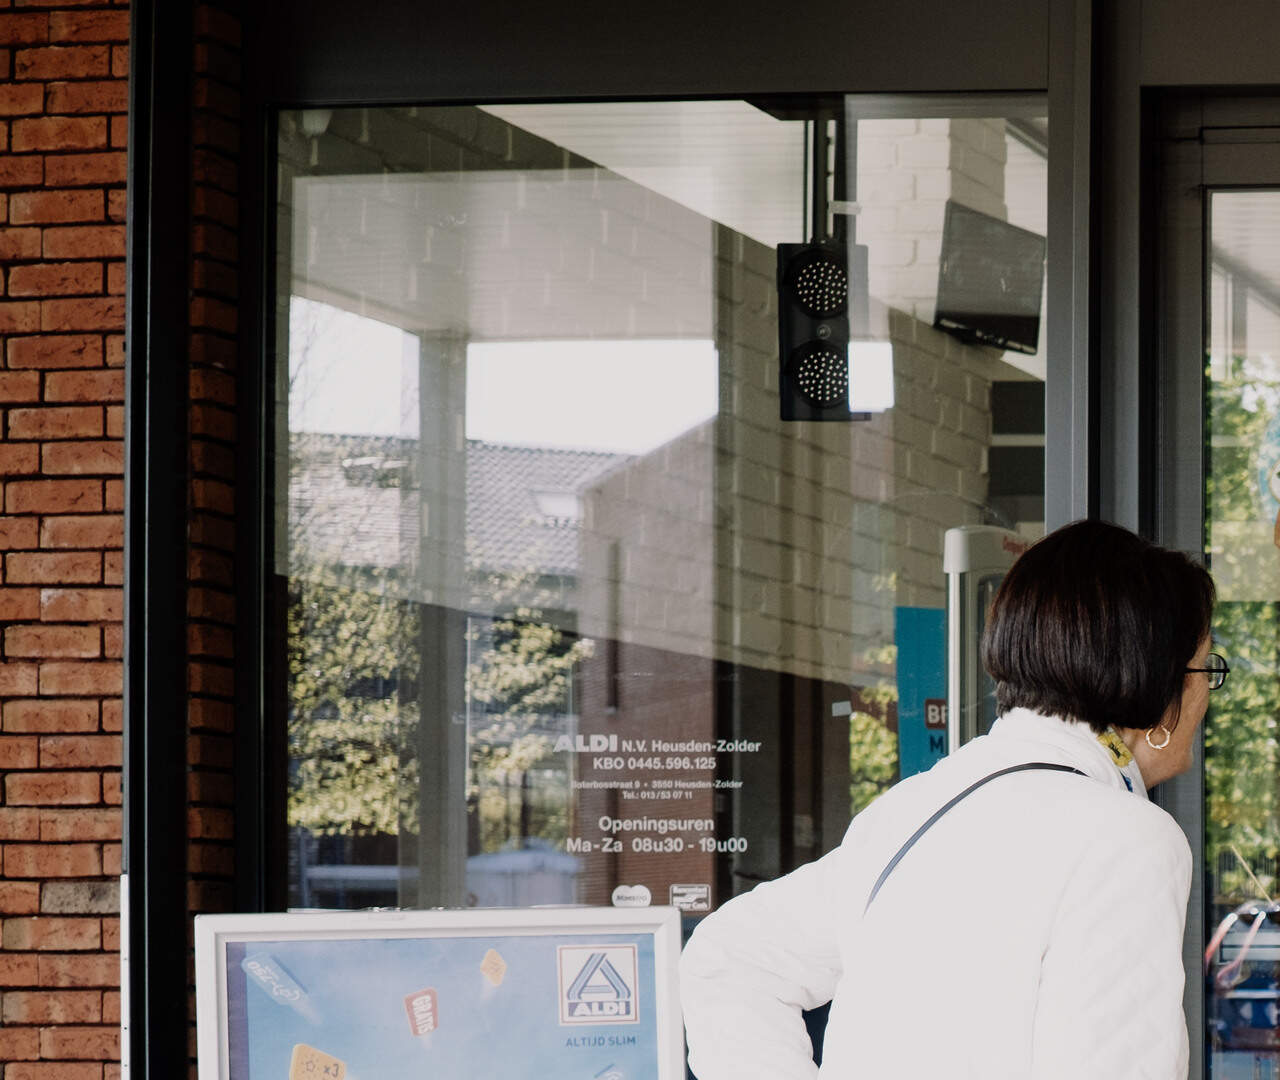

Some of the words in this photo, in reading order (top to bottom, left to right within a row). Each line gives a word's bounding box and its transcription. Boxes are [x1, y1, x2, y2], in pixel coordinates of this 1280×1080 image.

[553, 734, 618, 752] ALDI
[621, 739, 648, 753] N.V.
[651, 739, 762, 753] Heusden-Zolder
[593, 756, 625, 770] KBO
[627, 756, 717, 770] 0445.596.125
[674, 779, 744, 789] Heusden-Zolder
[672, 790, 683, 799] 07
[598, 815, 715, 834] Openingsuren
[566, 837, 623, 853] Ma-Za
[631, 837, 684, 853] 08u30
[698, 837, 748, 853] 19u00
[411, 994, 435, 1035] GRATIS
[573, 1001, 626, 1017] ALDI
[565, 1036, 606, 1048] ALTIJD
[607, 1035, 637, 1047] SLIM
